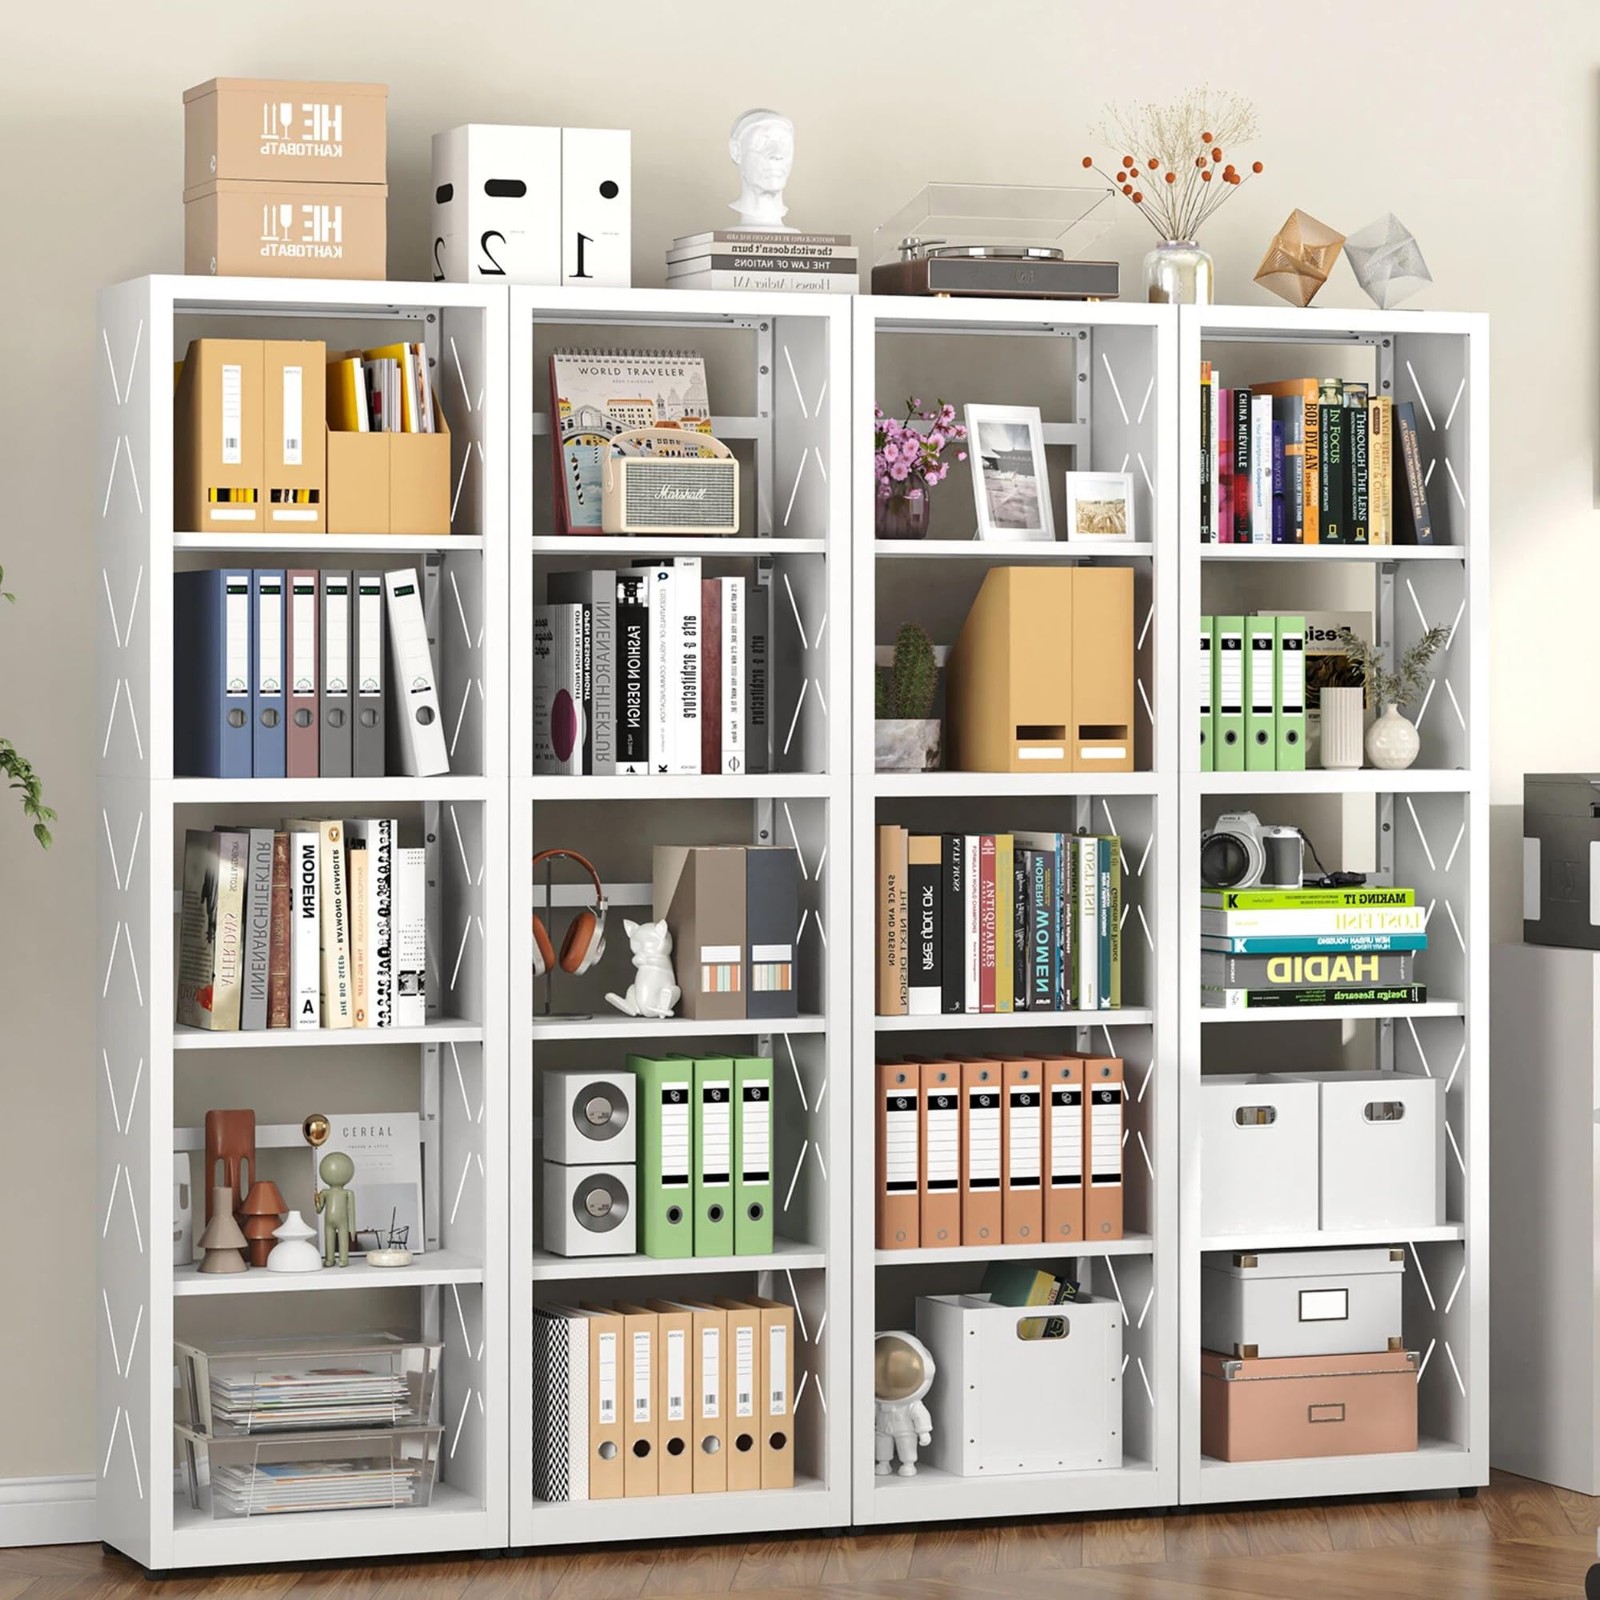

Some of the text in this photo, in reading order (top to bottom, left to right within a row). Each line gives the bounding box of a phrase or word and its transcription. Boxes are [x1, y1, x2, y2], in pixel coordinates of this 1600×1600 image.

[578, 367, 685, 377] WORLD TRAVELER
[1305, 403, 1318, 426] BOB
[1238, 393, 1249, 468] CHINA MIÉVILLE
[1330, 408, 1341, 464] IN FOCUS
[1304, 431, 1318, 470] DYLAN
[1356, 411, 1368, 521] THROUGH THE LENS
[654, 483, 707, 500] Marshall
[984, 880, 995, 967] ANTIQUAIRES
[302, 999, 314, 1014] A
[342, 1126, 393, 1138] CEREAL
